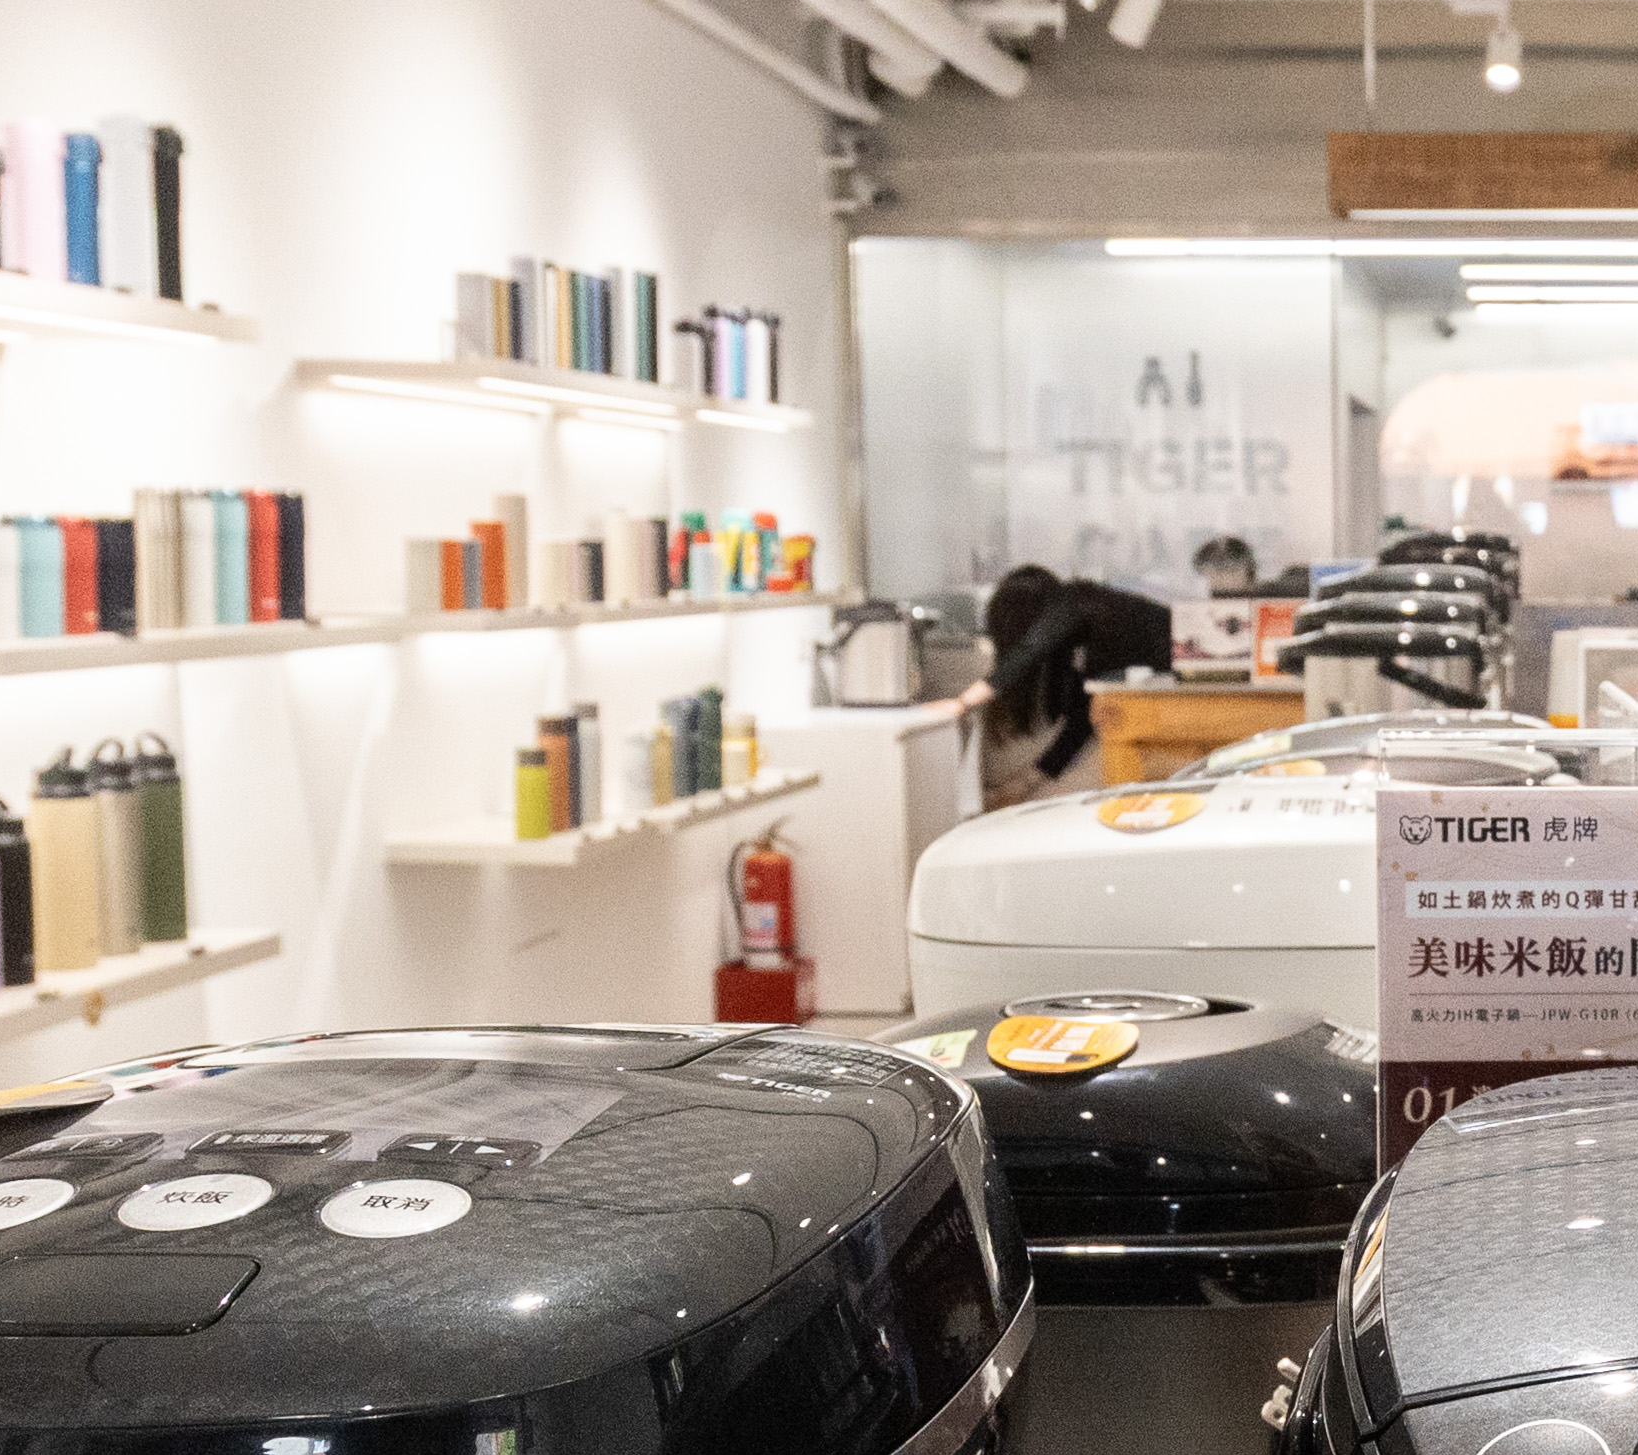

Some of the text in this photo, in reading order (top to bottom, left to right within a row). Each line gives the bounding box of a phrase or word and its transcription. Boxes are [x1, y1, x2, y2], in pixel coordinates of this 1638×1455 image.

[1434, 816, 1599, 843] TIGER 虎牌
[156, 1189, 234, 1207] 炊飯
[362, 1194, 435, 1212] 取消
